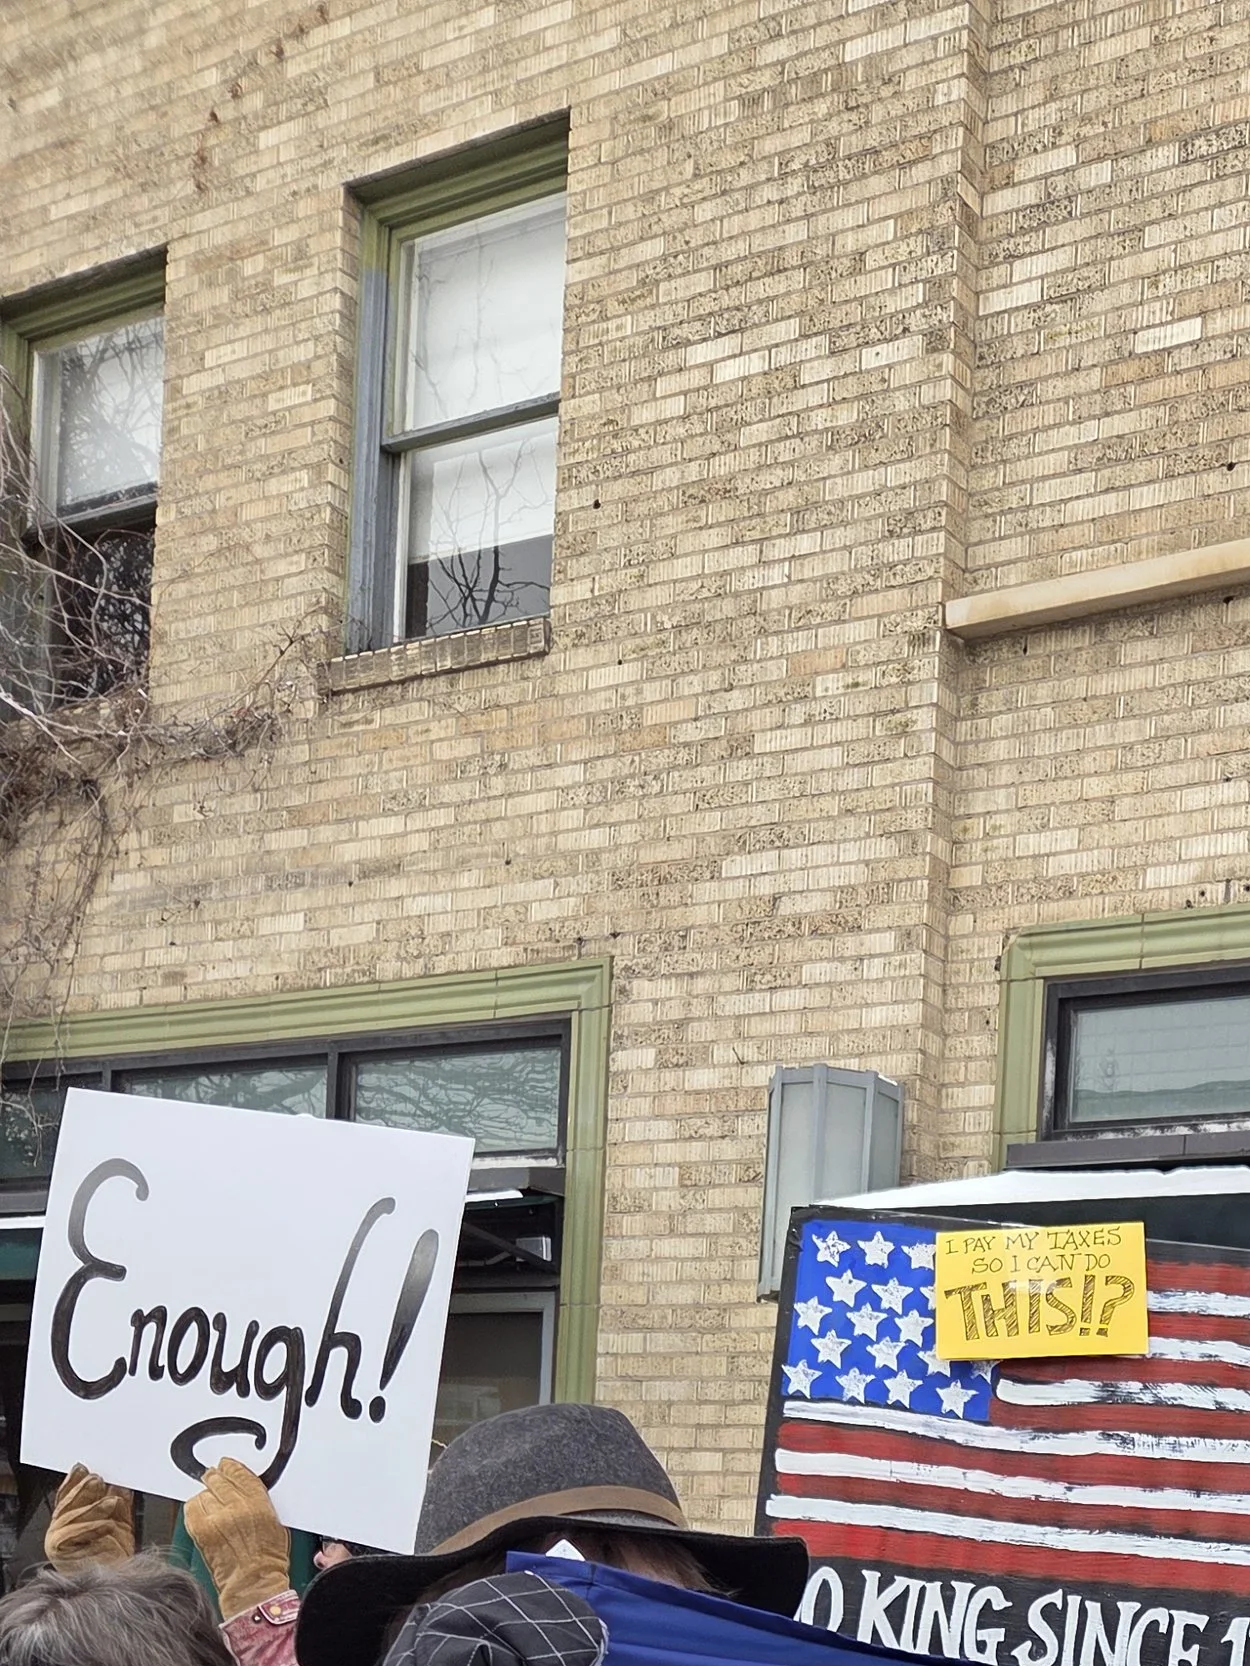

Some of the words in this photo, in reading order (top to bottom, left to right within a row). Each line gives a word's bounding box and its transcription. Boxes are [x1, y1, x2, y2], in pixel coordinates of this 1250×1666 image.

[946, 1239, 958, 1254] I
[963, 1236, 996, 1253] PAY
[1005, 1232, 1040, 1250] MY
[1047, 1226, 1121, 1250] TAXES
[972, 1257, 1003, 1274] SO
[1010, 1256, 1020, 1272] I
[1027, 1253, 1082, 1273] CAN
[1085, 1253, 1110, 1271] DO
[50, 1157, 440, 1488] Enough!
[944, 1274, 1134, 1340] THIS!?
[793, 1566, 844, 1632] O
[857, 1570, 1012, 1666] KING
